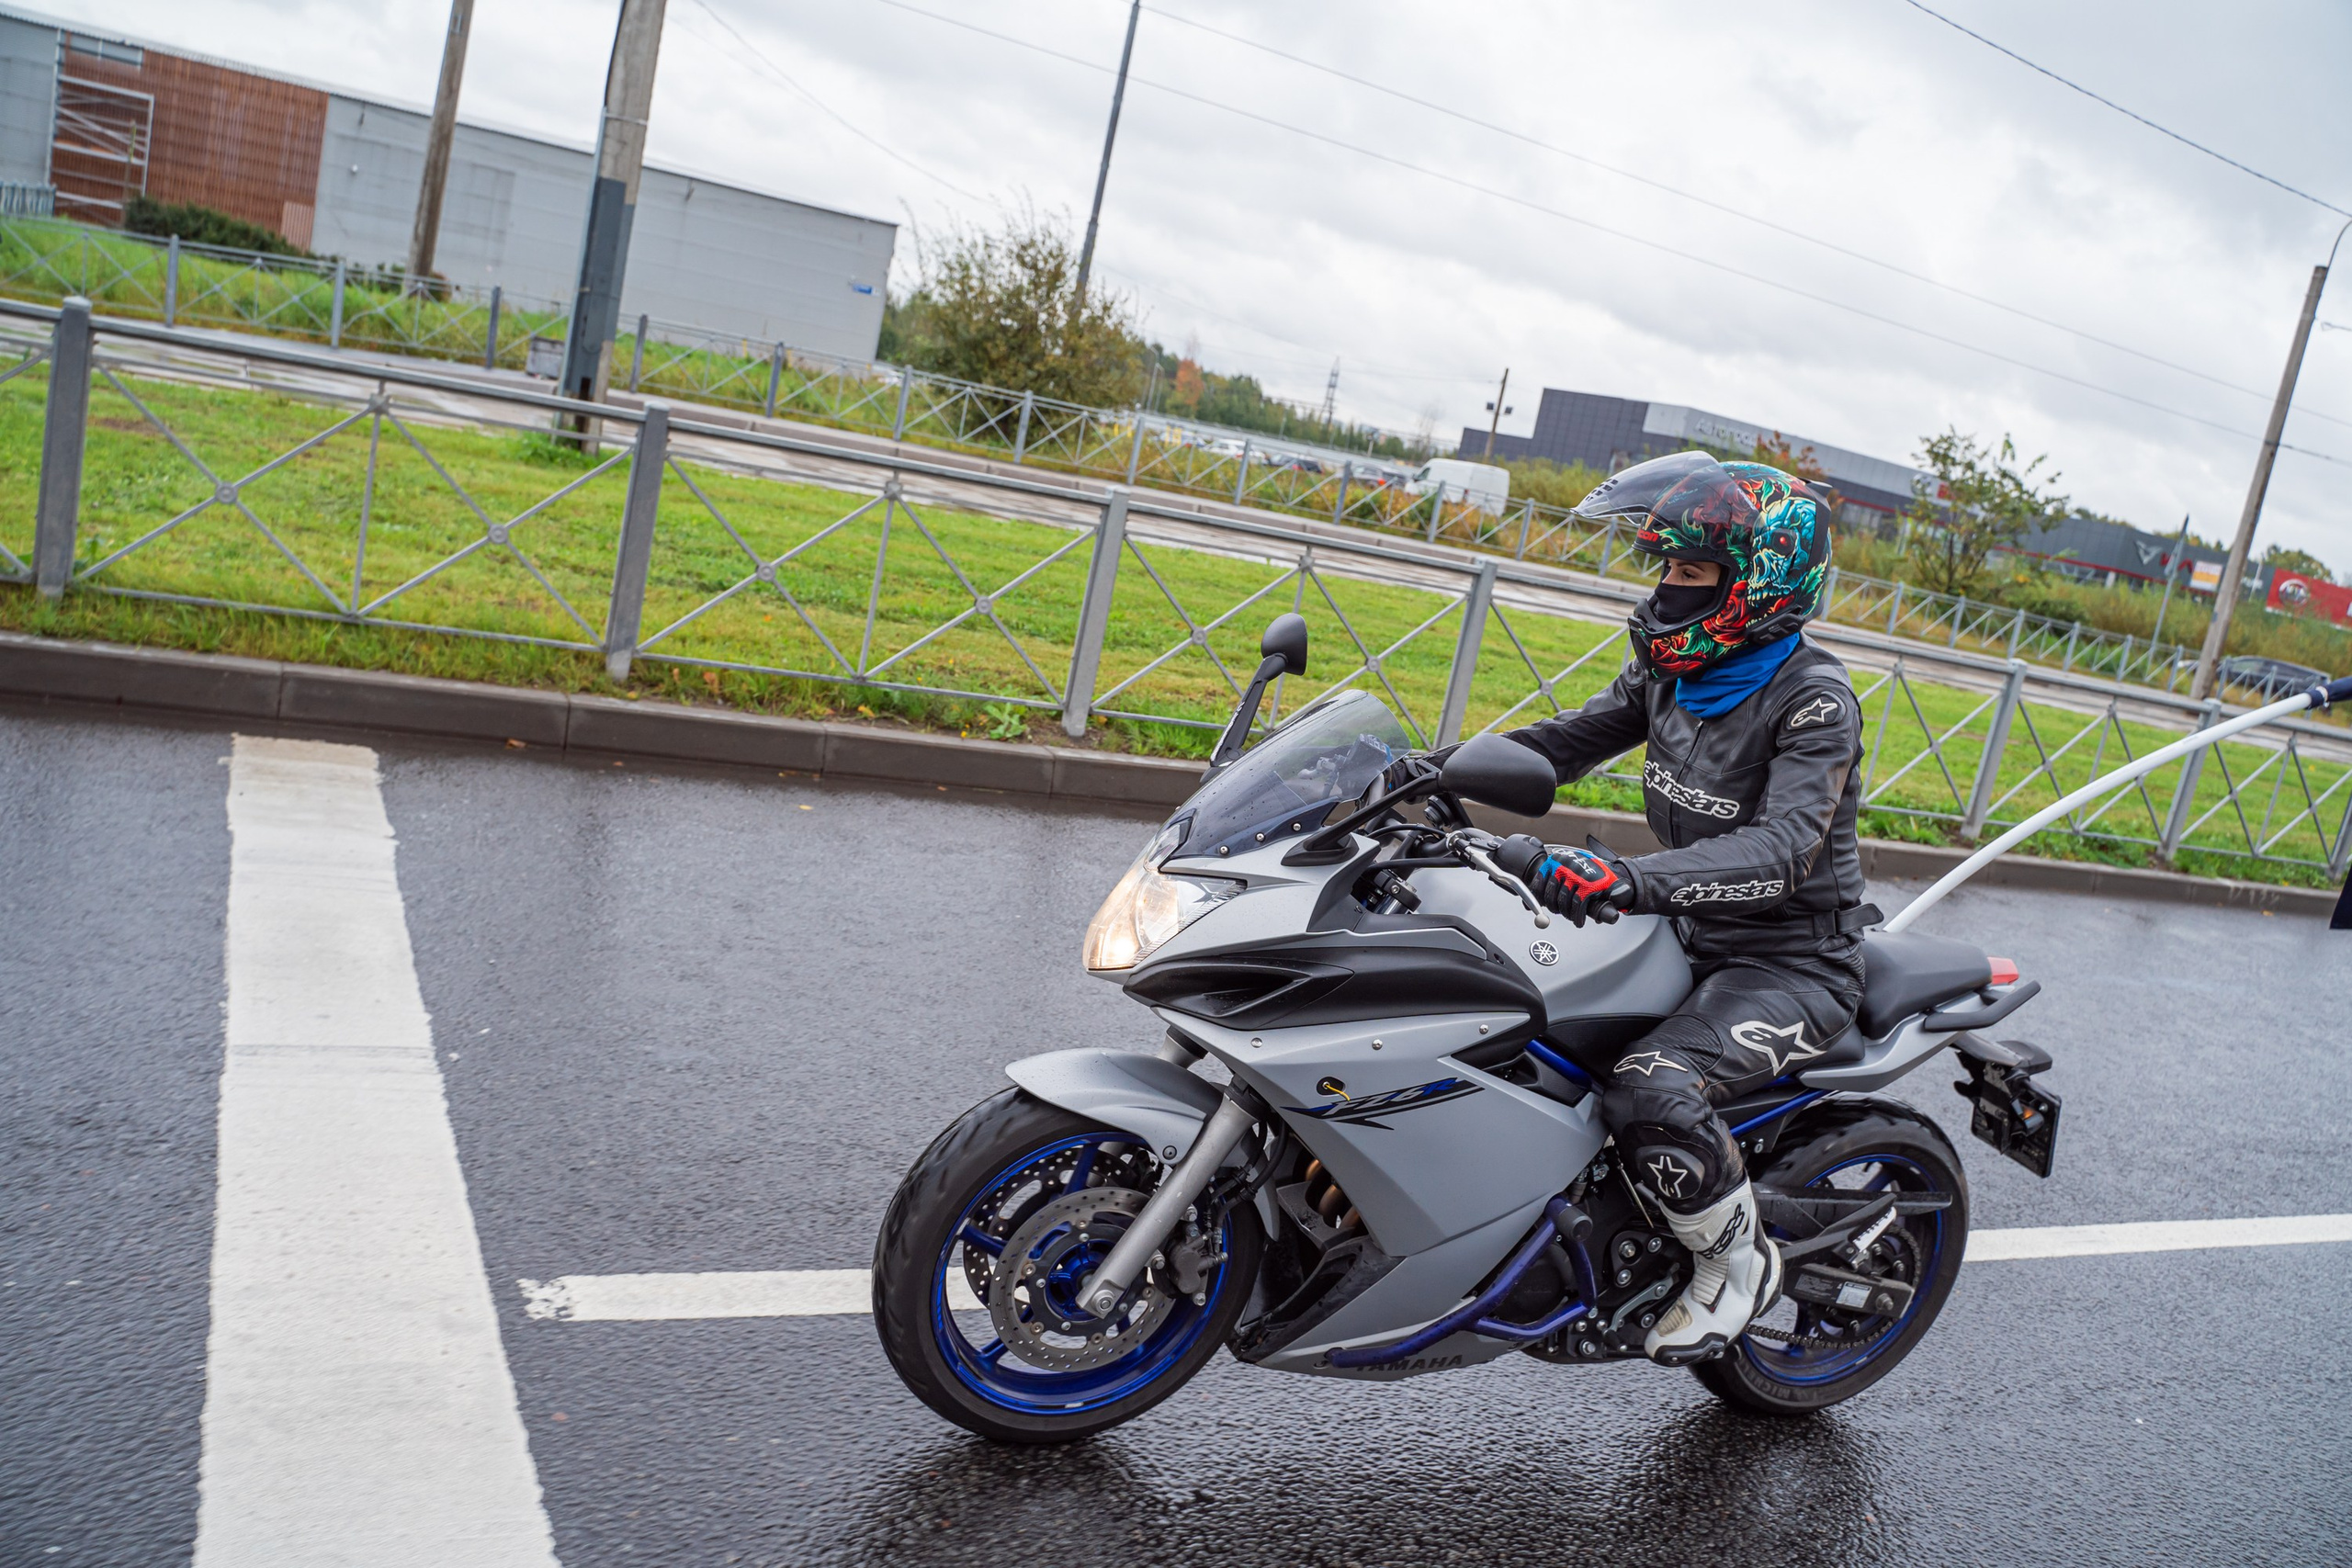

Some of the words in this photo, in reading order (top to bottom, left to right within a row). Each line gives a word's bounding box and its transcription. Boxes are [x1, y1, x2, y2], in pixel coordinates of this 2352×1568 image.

[1644, 760, 1740, 819] alpinestars
[1670, 880, 1784, 906] alpinestars
[1321, 1077, 1458, 1117] FZ6R
